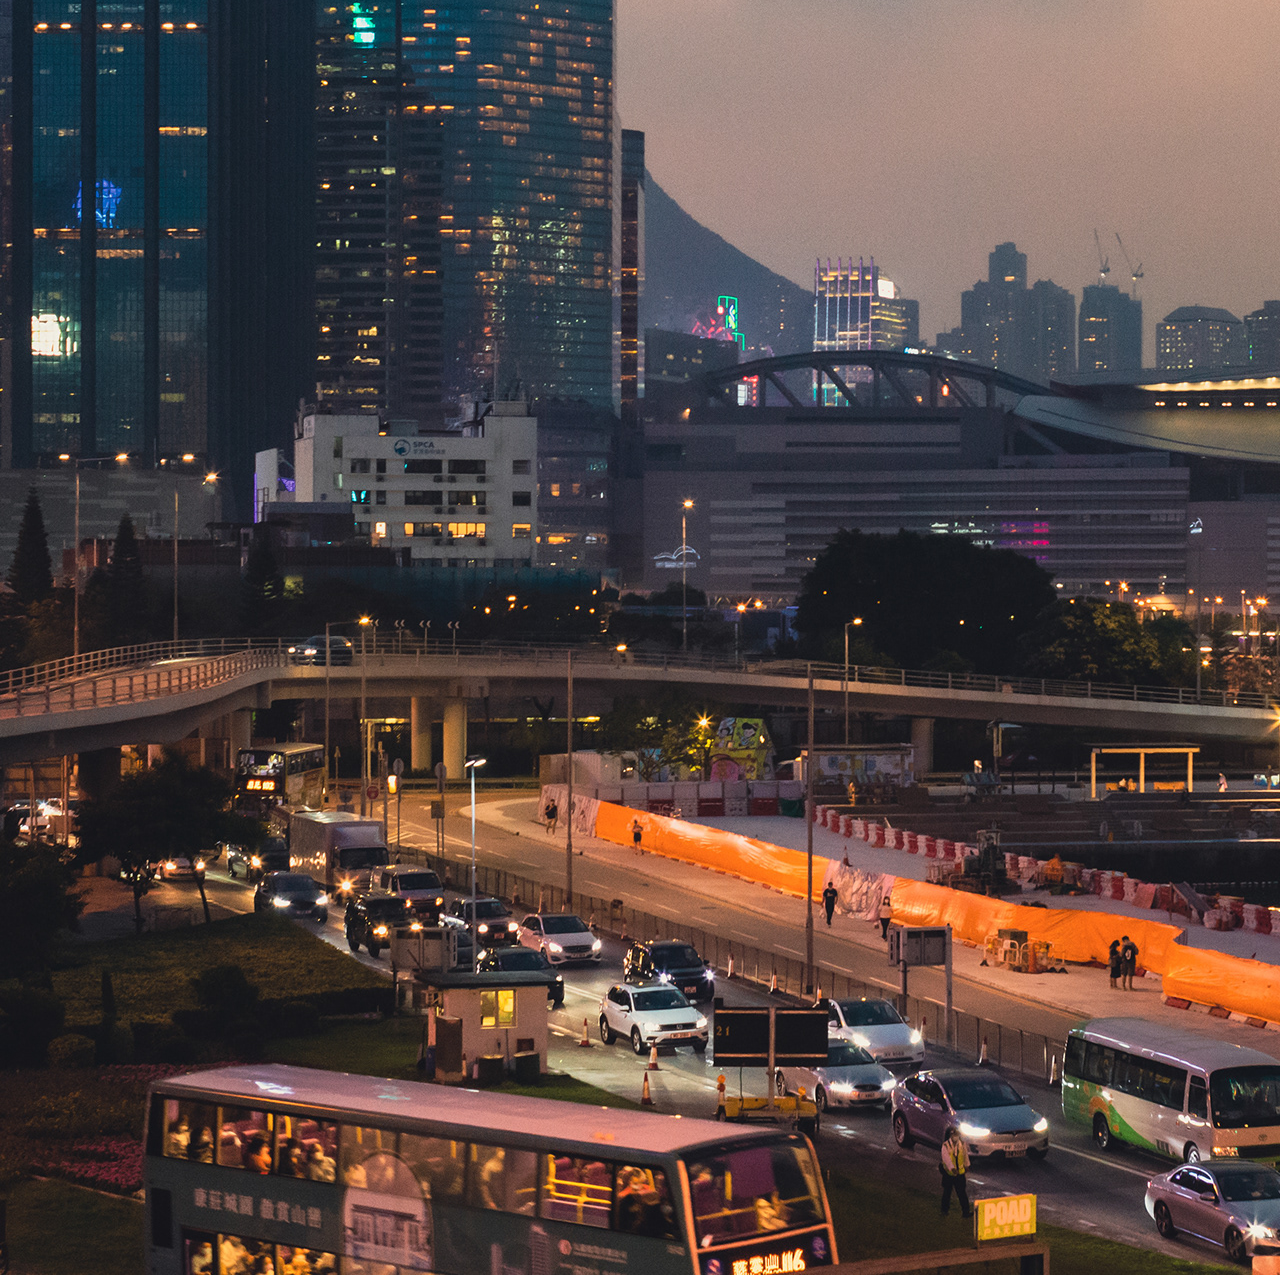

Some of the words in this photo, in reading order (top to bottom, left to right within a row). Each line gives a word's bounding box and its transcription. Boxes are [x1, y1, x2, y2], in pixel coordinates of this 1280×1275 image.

[716, 1026, 730, 1036] 21
[984, 1198, 1031, 1227] POAD
[782, 1248, 805, 1273] 116
